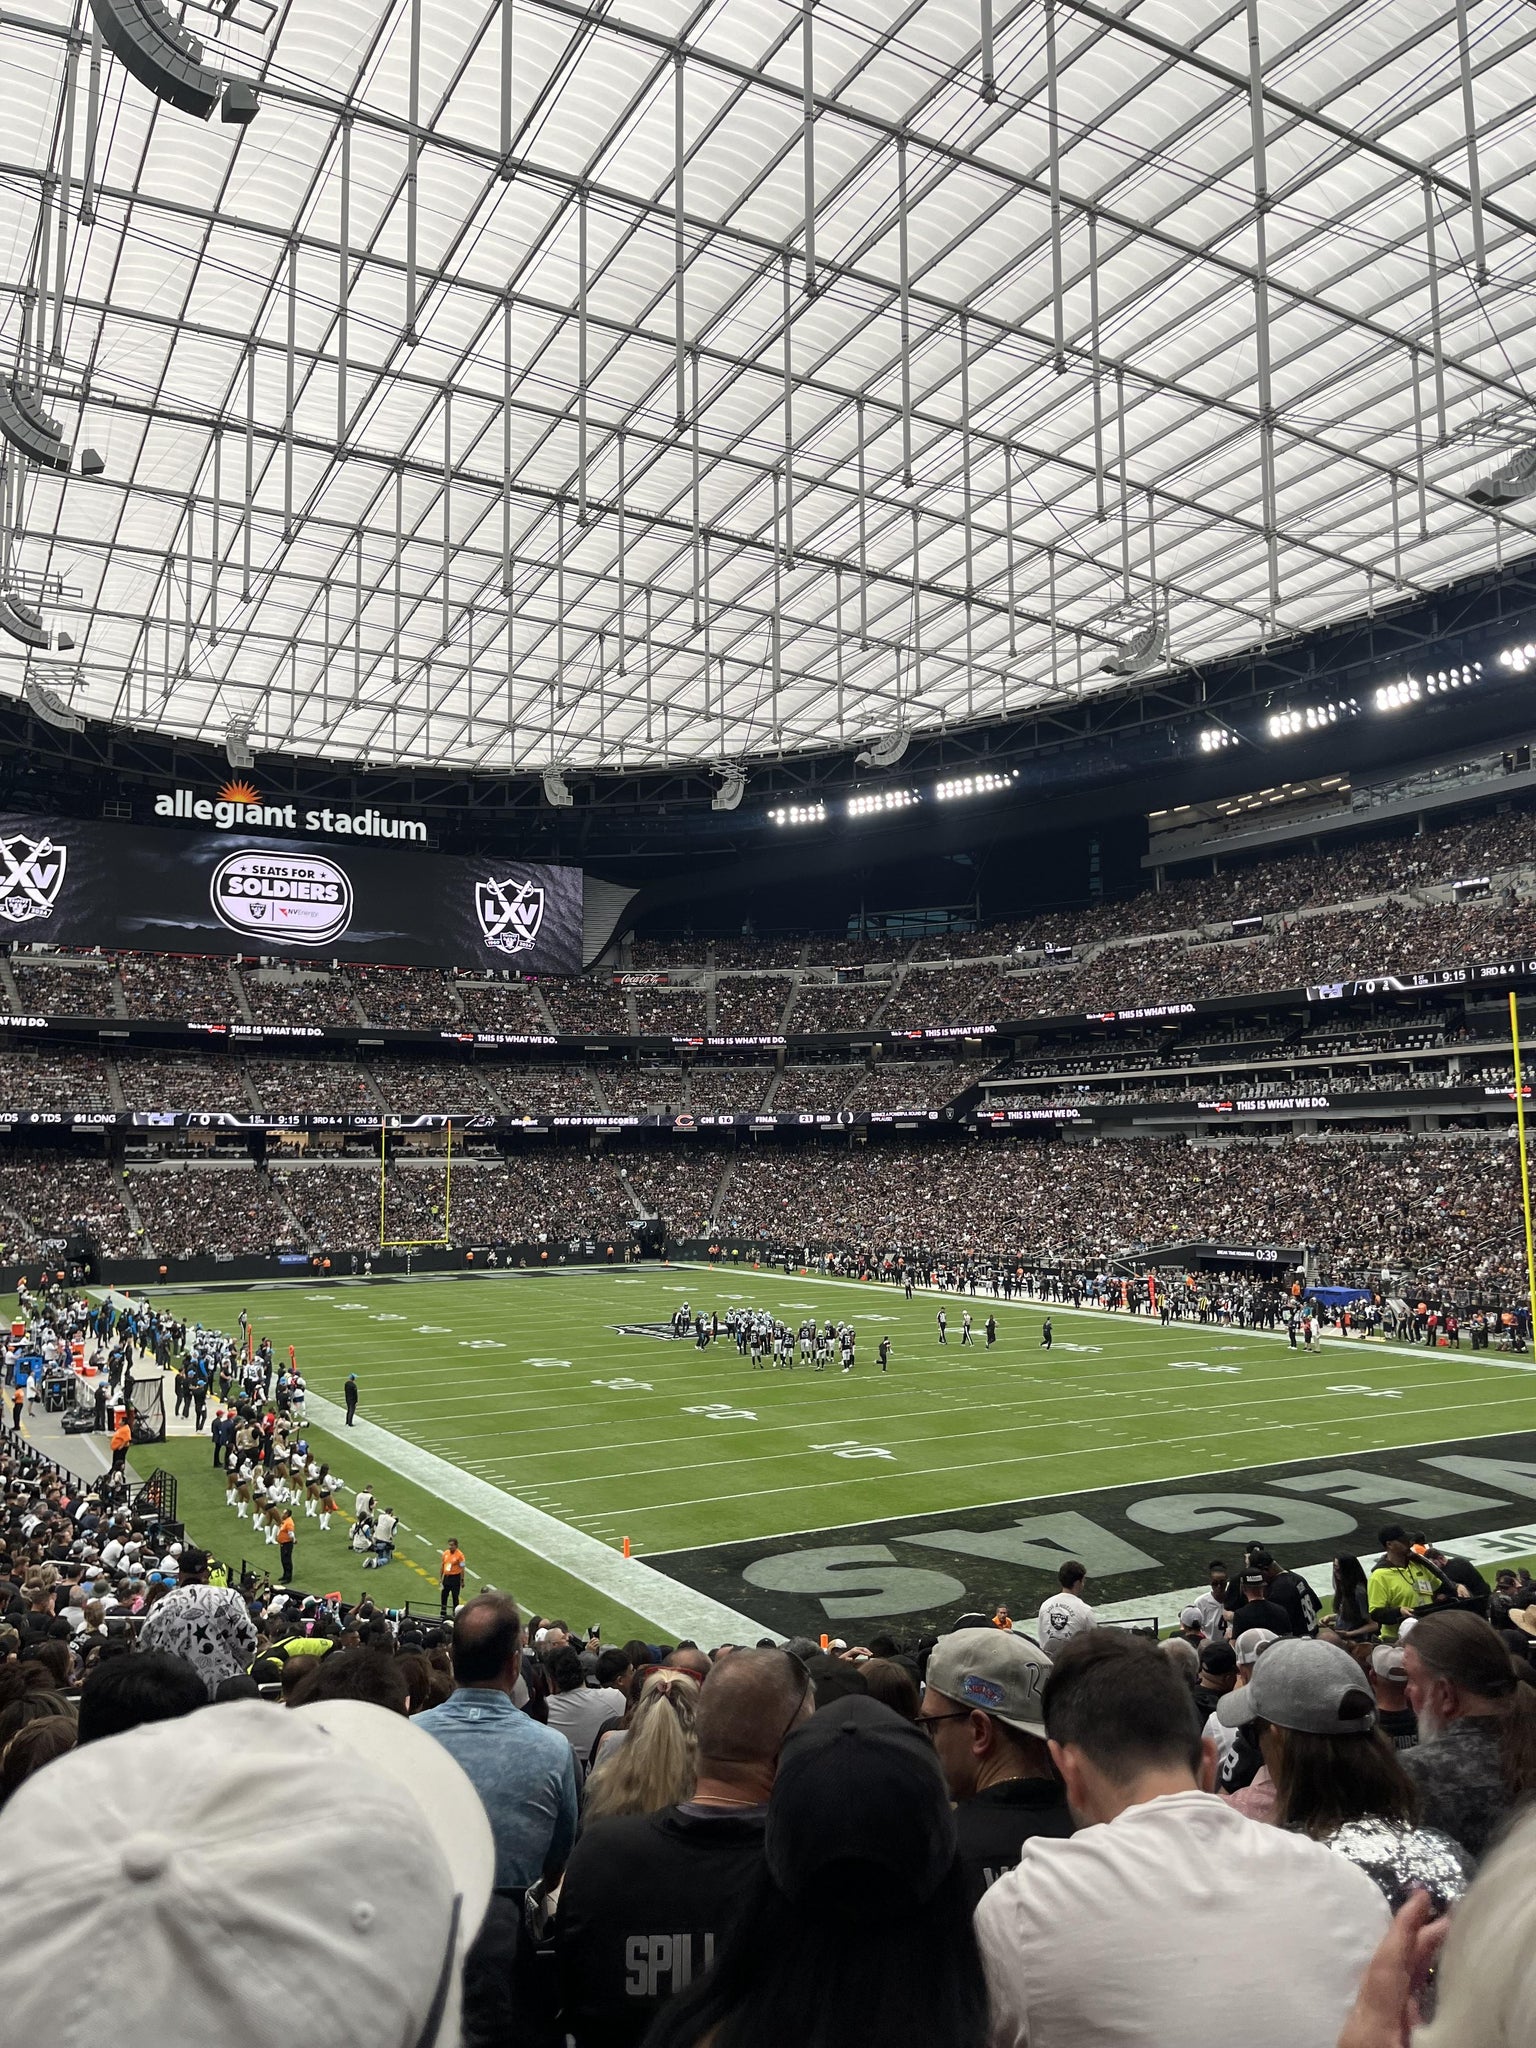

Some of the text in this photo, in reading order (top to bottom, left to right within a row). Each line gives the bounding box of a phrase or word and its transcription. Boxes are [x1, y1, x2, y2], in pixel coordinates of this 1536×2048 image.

[154, 789, 427, 841] allegiant stadium
[0, 860, 59, 889] XV
[252, 865, 315, 879] SEATS FOR
[228, 876, 339, 902] SOLDIERS
[484, 899, 540, 925] LXV
[1443, 970, 1466, 982] 9:15
[1481, 964, 1516, 977] 3RD & 4
[1118, 1009, 1135, 1019] THIS
[1136, 1009, 1144, 1017] IS
[1144, 1006, 1168, 1017] WHAT
[1168, 1005, 1180, 1014] WE
[1180, 1003, 1196, 1013] DO.
[10, 1016, 27, 1026] WE
[28, 1018, 49, 1028] DO.
[231, 1025, 252, 1034] THIS
[253, 1026, 262, 1034] IS
[263, 1026, 291, 1035] WHAT
[291, 1027, 306, 1036] WE
[307, 1028, 325, 1037] DO.
[925, 1029, 941, 1037] THIS
[949, 1027, 972, 1035] WHAT
[972, 1026, 984, 1034] WE
[984, 1025, 998, 1033] DO.
[478, 1034, 495, 1042] THIS
[505, 1035, 529, 1043] WHAT
[543, 1036, 558, 1044] DO.
[708, 1037, 725, 1045] THIS
[726, 1037, 734, 1045] IS
[759, 1036, 772, 1044] WE
[1236, 1101, 1255, 1111] THIS
[1257, 1100, 1266, 1110] IS
[1266, 1099, 1294, 1109] WHAT
[1294, 1098, 1310, 1108] WE
[1311, 1097, 1330, 1107] DO.
[31, 1113, 62, 1123] 0 TDS
[74, 1113, 116, 1124] 61 LONG
[278, 1115, 300, 1124] 9:15
[313, 1116, 329, 1124] 3RD
[701, 1116, 715, 1124] CHI
[1007, 1111, 1023, 1120] THIS
[1024, 1111, 1031, 1119] IS
[1031, 1110, 1055, 1119] WHAT
[1055, 1110, 1067, 1118] WE
[1067, 1109, 1081, 1117] DO.
[440, 1116, 448, 1127] 7
[554, 1117, 639, 1125] OUT OF TOWN SCORES
[1256, 1249, 1278, 1261] 0:39
[680, 1403, 759, 1421] 20
[807, 1440, 898, 1461] 10
[1222, 1749, 1240, 1783] 8
